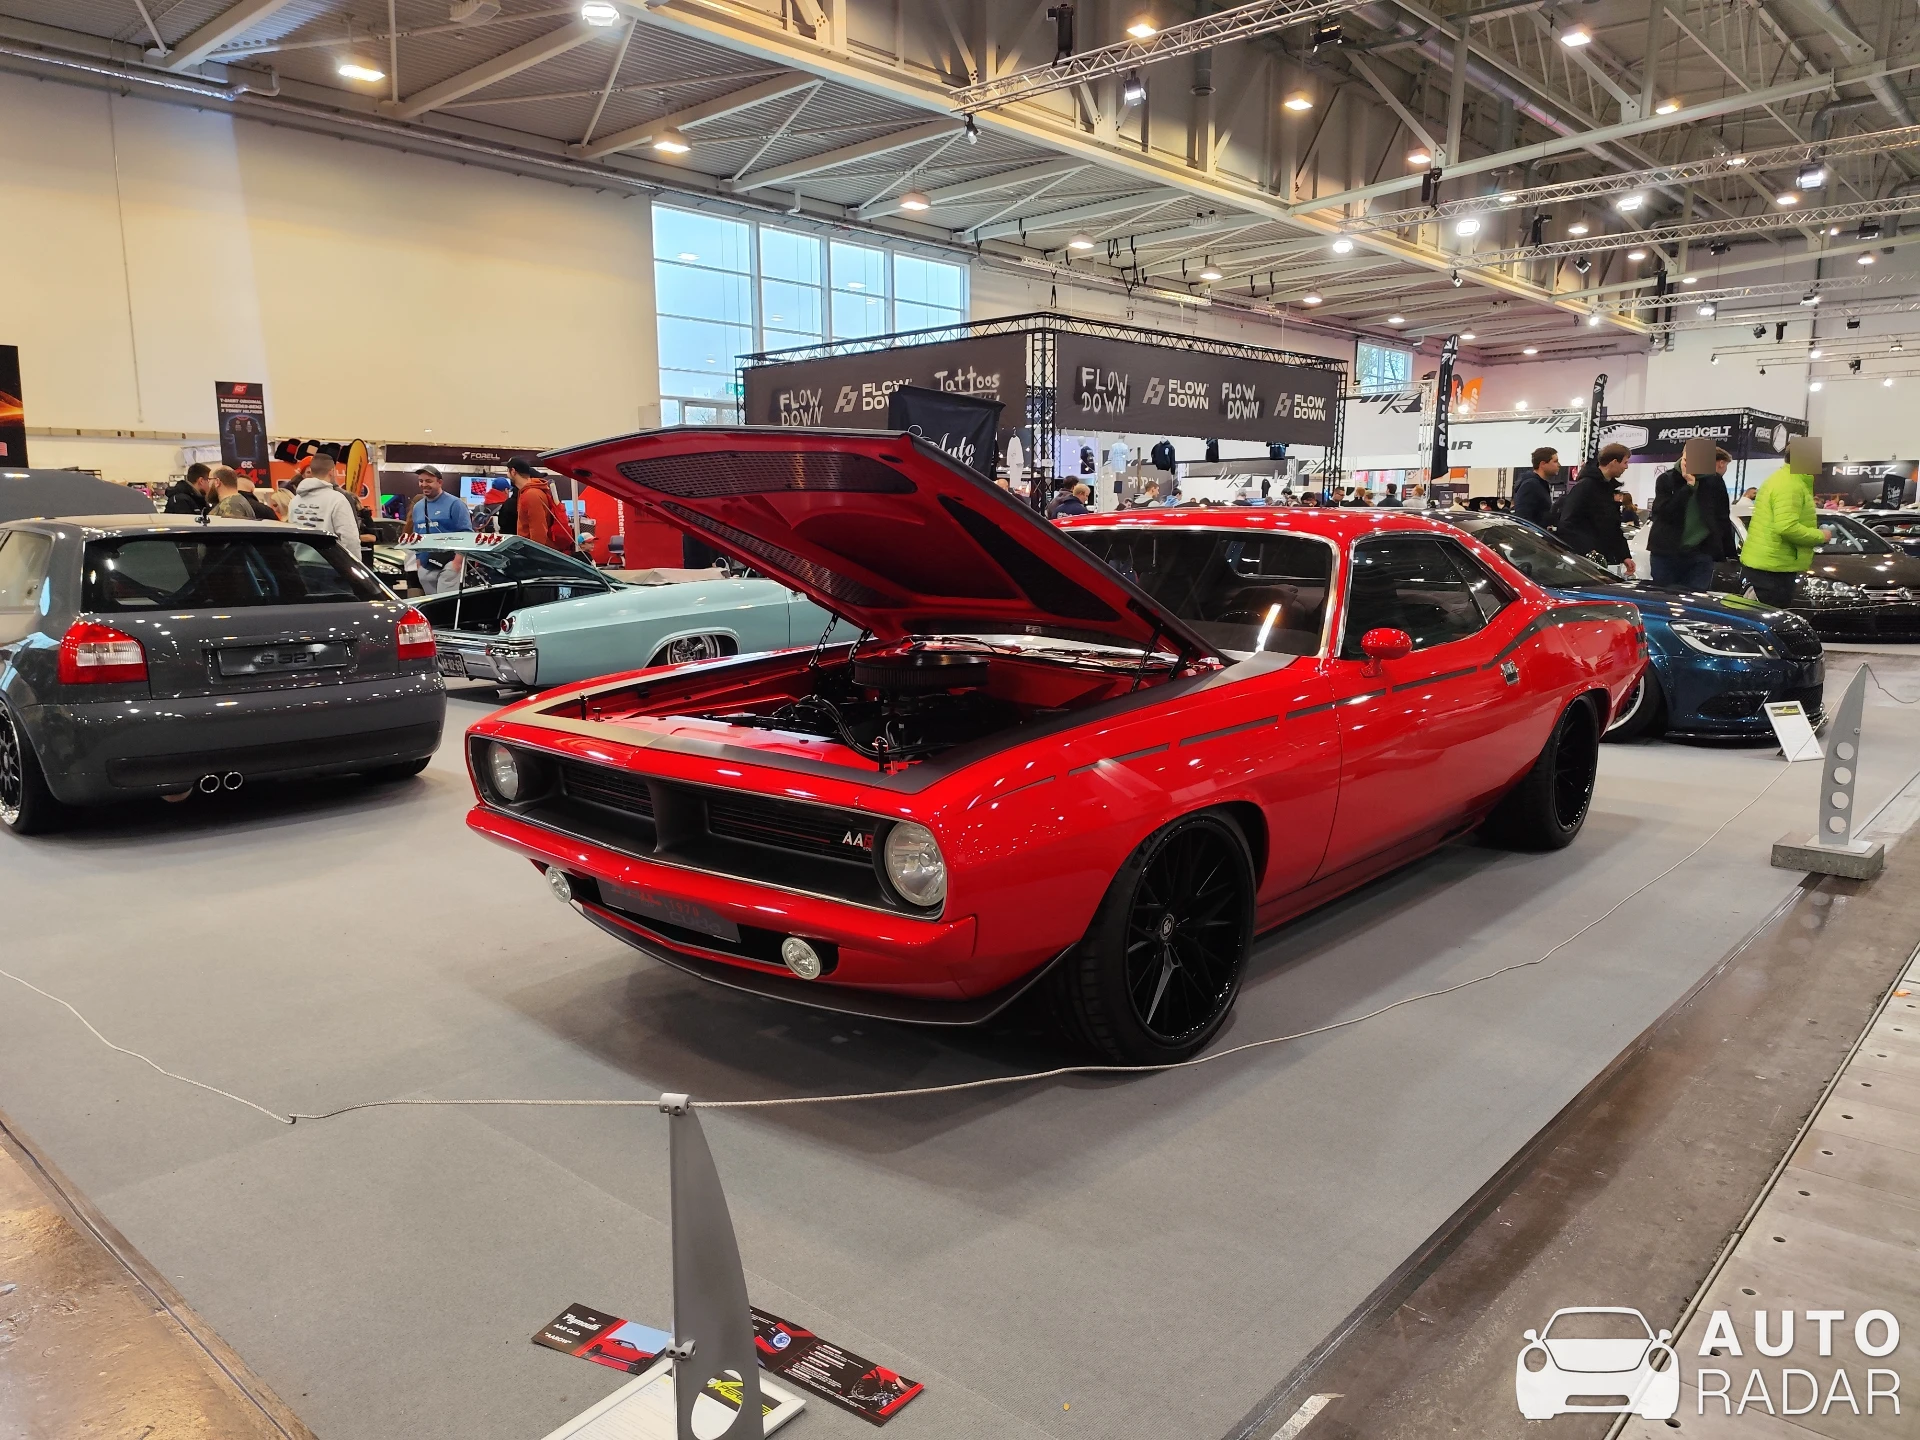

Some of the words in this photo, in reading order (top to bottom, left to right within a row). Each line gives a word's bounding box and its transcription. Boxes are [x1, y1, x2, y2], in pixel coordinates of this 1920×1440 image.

[934, 366, 1000, 391] Tattoos
[1082, 367, 1128, 396] FLOW
[1168, 379, 1207, 396] FLOW
[779, 388, 822, 411] FLOW
[1221, 382, 1256, 401] FLOW
[1081, 391, 1126, 415] DOWN
[1168, 393, 1209, 410] DOWN
[1228, 400, 1260, 420] DOWN
[1294, 394, 1325, 409] FLOW
[781, 405, 824, 427] DOWN
[1293, 407, 1327, 422] DOWN
[1658, 425, 1732, 440] #GEBÜGELT
[1831, 465, 1899, 476] HERTZ
[842, 830, 874, 848] AAR
